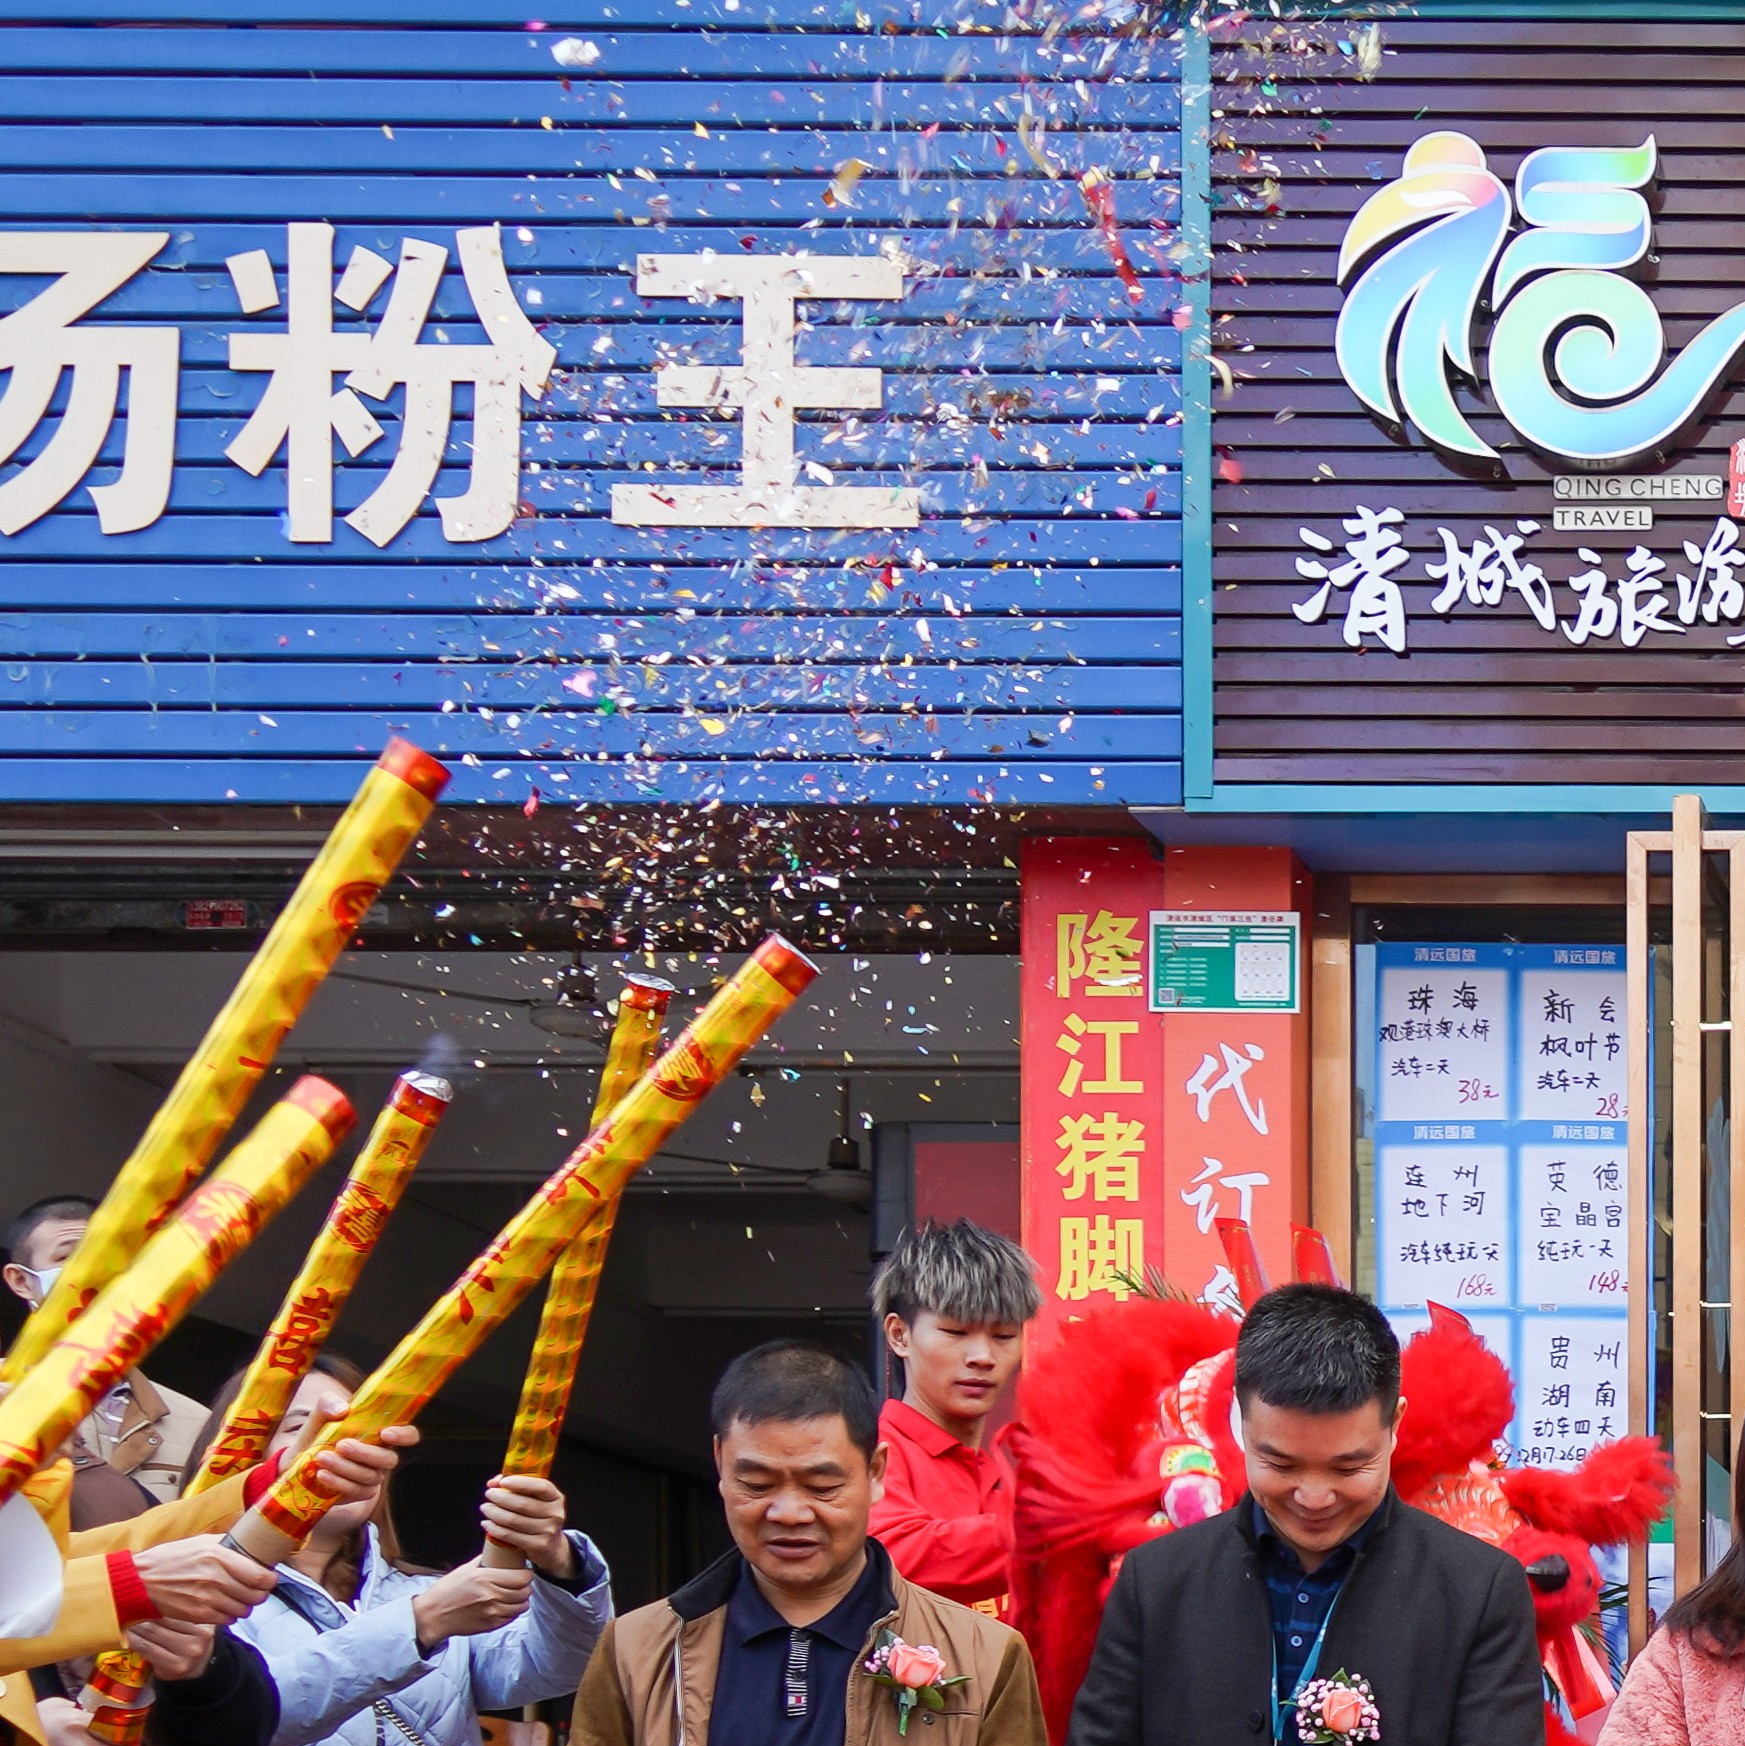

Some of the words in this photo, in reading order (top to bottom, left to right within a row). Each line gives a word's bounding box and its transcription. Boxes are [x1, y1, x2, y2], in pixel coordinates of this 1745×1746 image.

[1554, 478, 1622, 497] QING
[1630, 478, 1723, 497] CHENG
[1556, 510, 1650, 527] TRAVEL
[1414, 947, 1477, 962] 清远国旅
[1553, 949, 1616, 964] 清远国旅
[1055, 909, 1146, 1302] 隆江猪脚
